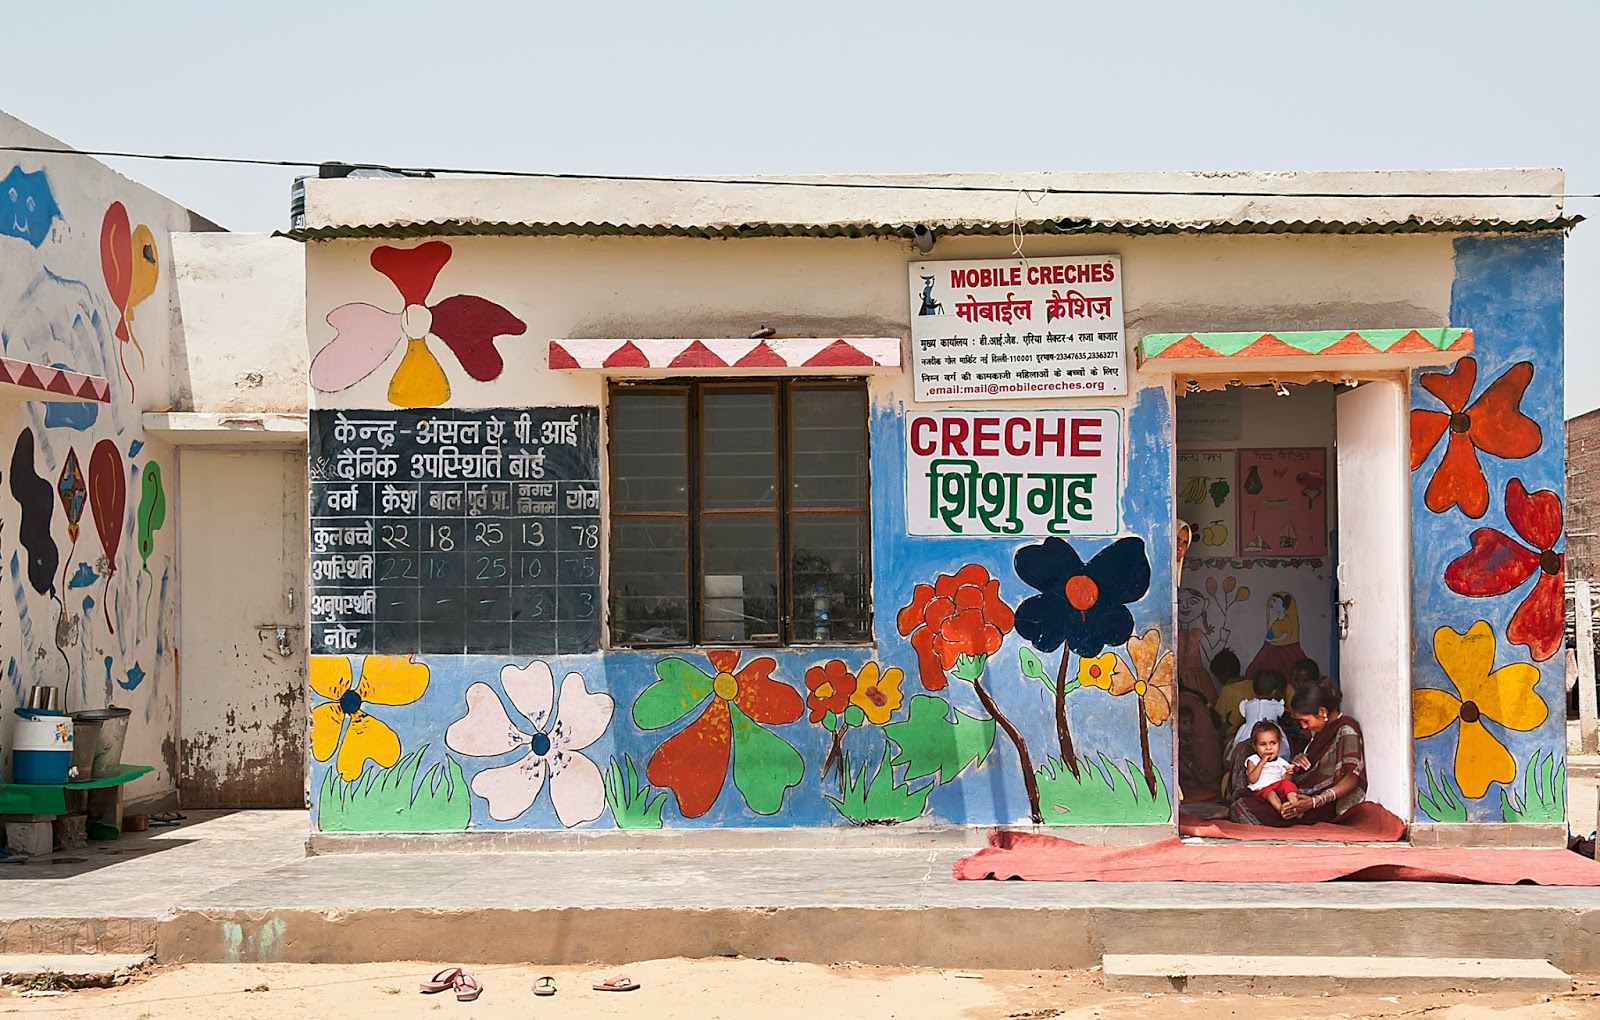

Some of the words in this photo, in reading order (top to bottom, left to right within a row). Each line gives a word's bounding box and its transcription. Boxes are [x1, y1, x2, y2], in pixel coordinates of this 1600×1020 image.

[951, 267, 1022, 288] MOBILE
[1027, 263, 1115, 285] CRECHES
[955, 292, 1032, 325] मोबाईल
[920, 339, 936, 351] मुख्य
[940, 335, 968, 347] कार्यालय
[1023, 332, 1042, 346] एरिया
[1078, 333, 1093, 342] राजा
[980, 354, 988, 365] नई
[921, 373, 939, 382] निम्न
[944, 372, 956, 381] वर्ग
[961, 371, 971, 381] की
[976, 369, 1011, 380] कामकाजी
[1054, 368, 1062, 377] के
[1090, 366, 1098, 376] के
[1103, 366, 1118, 377] लिए
[929, 381, 1104, 394] email:mail@mobilecreches.org
[416, 416, 482, 444] अंसल
[910, 417, 1102, 457] CRECHE
[337, 447, 399, 480] दैनिक
[410, 446, 502, 479] उपस्थिति
[508, 447, 546, 479] बोर्ड
[327, 484, 359, 511] वर्ग
[381, 484, 418, 514] क्रैश
[429, 490, 462, 511] बाल
[468, 484, 488, 516] पूर्व
[518, 484, 553, 497] नगर
[566, 485, 600, 510] योग
[517, 497, 557, 514] निगम
[925, 459, 1024, 533] शिशु
[1027, 473, 1097, 534] गृह
[314, 527, 342, 552] कुल
[344, 520, 373, 546] बच्चे
[430, 524, 454, 552] 18
[522, 522, 545, 547] 13
[571, 525, 599, 549] 78
[313, 555, 373, 580] उपस्थिति
[380, 558, 418, 580] 22
[430, 558, 446, 579] 18
[476, 557, 506, 579] 25
[521, 557, 541, 578] 10
[532, 593, 544, 617] 3
[577, 592, 594, 617] 3
[324, 624, 360, 649] नोट
